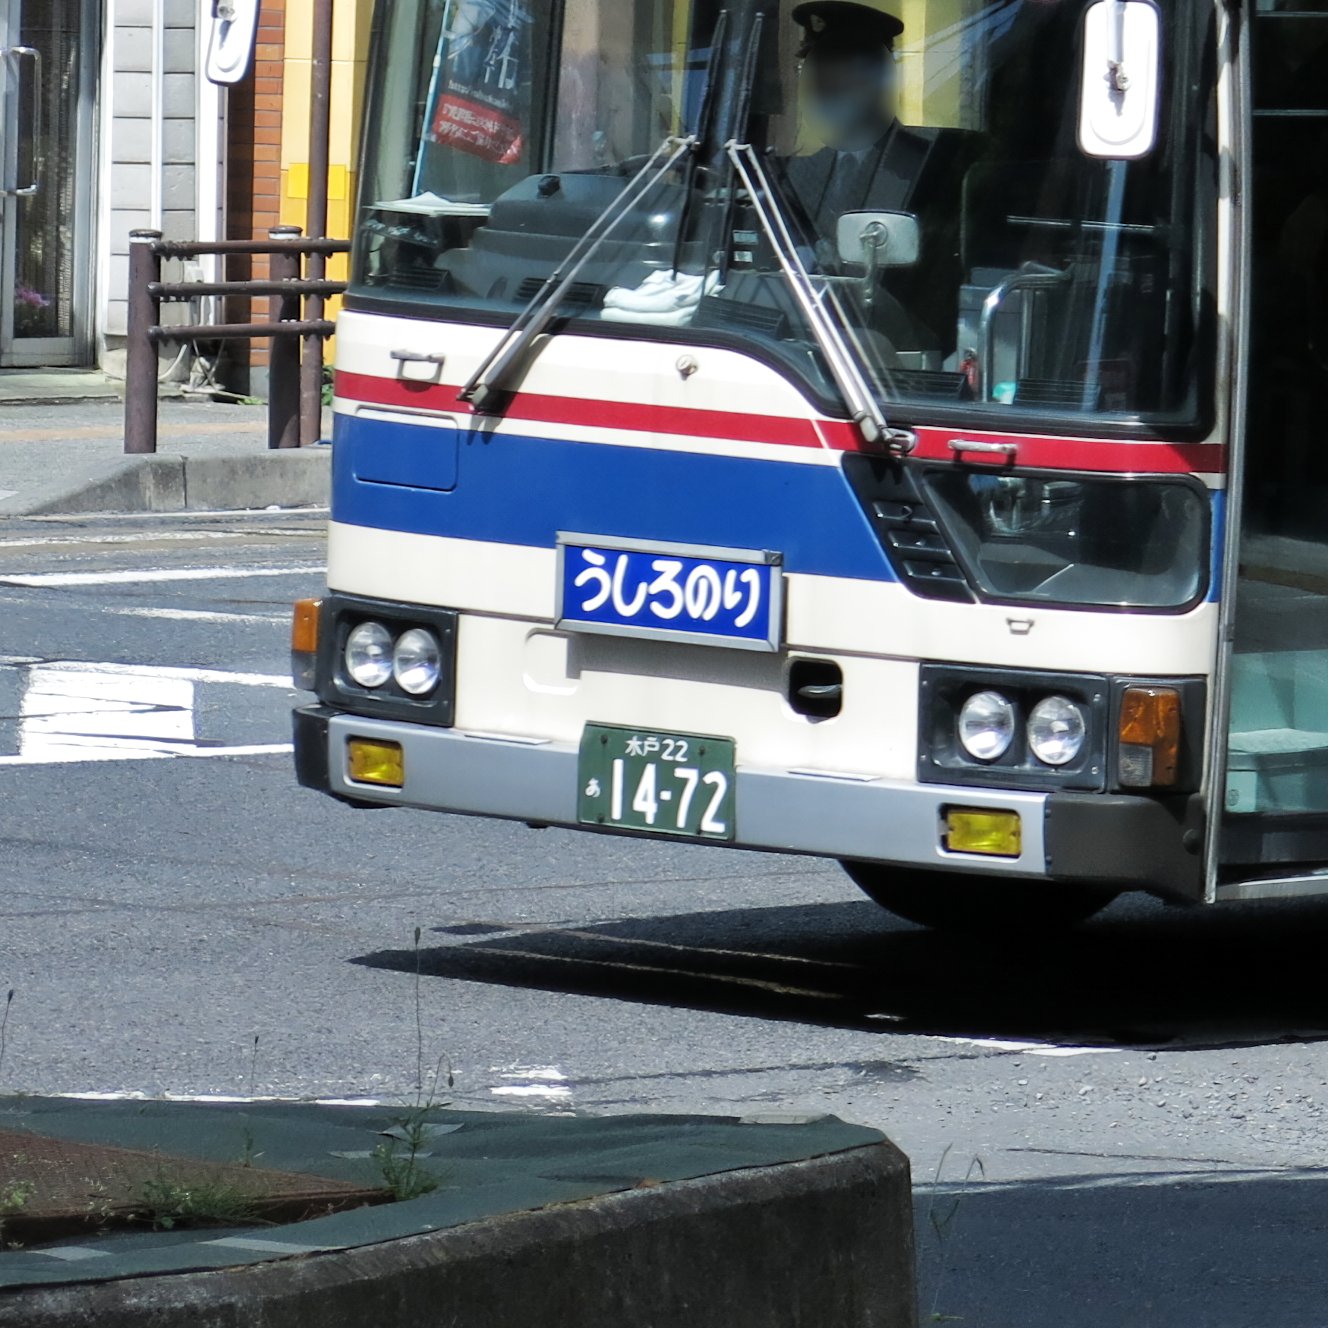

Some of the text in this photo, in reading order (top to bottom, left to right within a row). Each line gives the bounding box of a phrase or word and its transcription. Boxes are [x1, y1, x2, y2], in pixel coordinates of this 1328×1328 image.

[574, 548, 761, 628] うしろのり
[585, 758, 728, 834] あ 14-72
